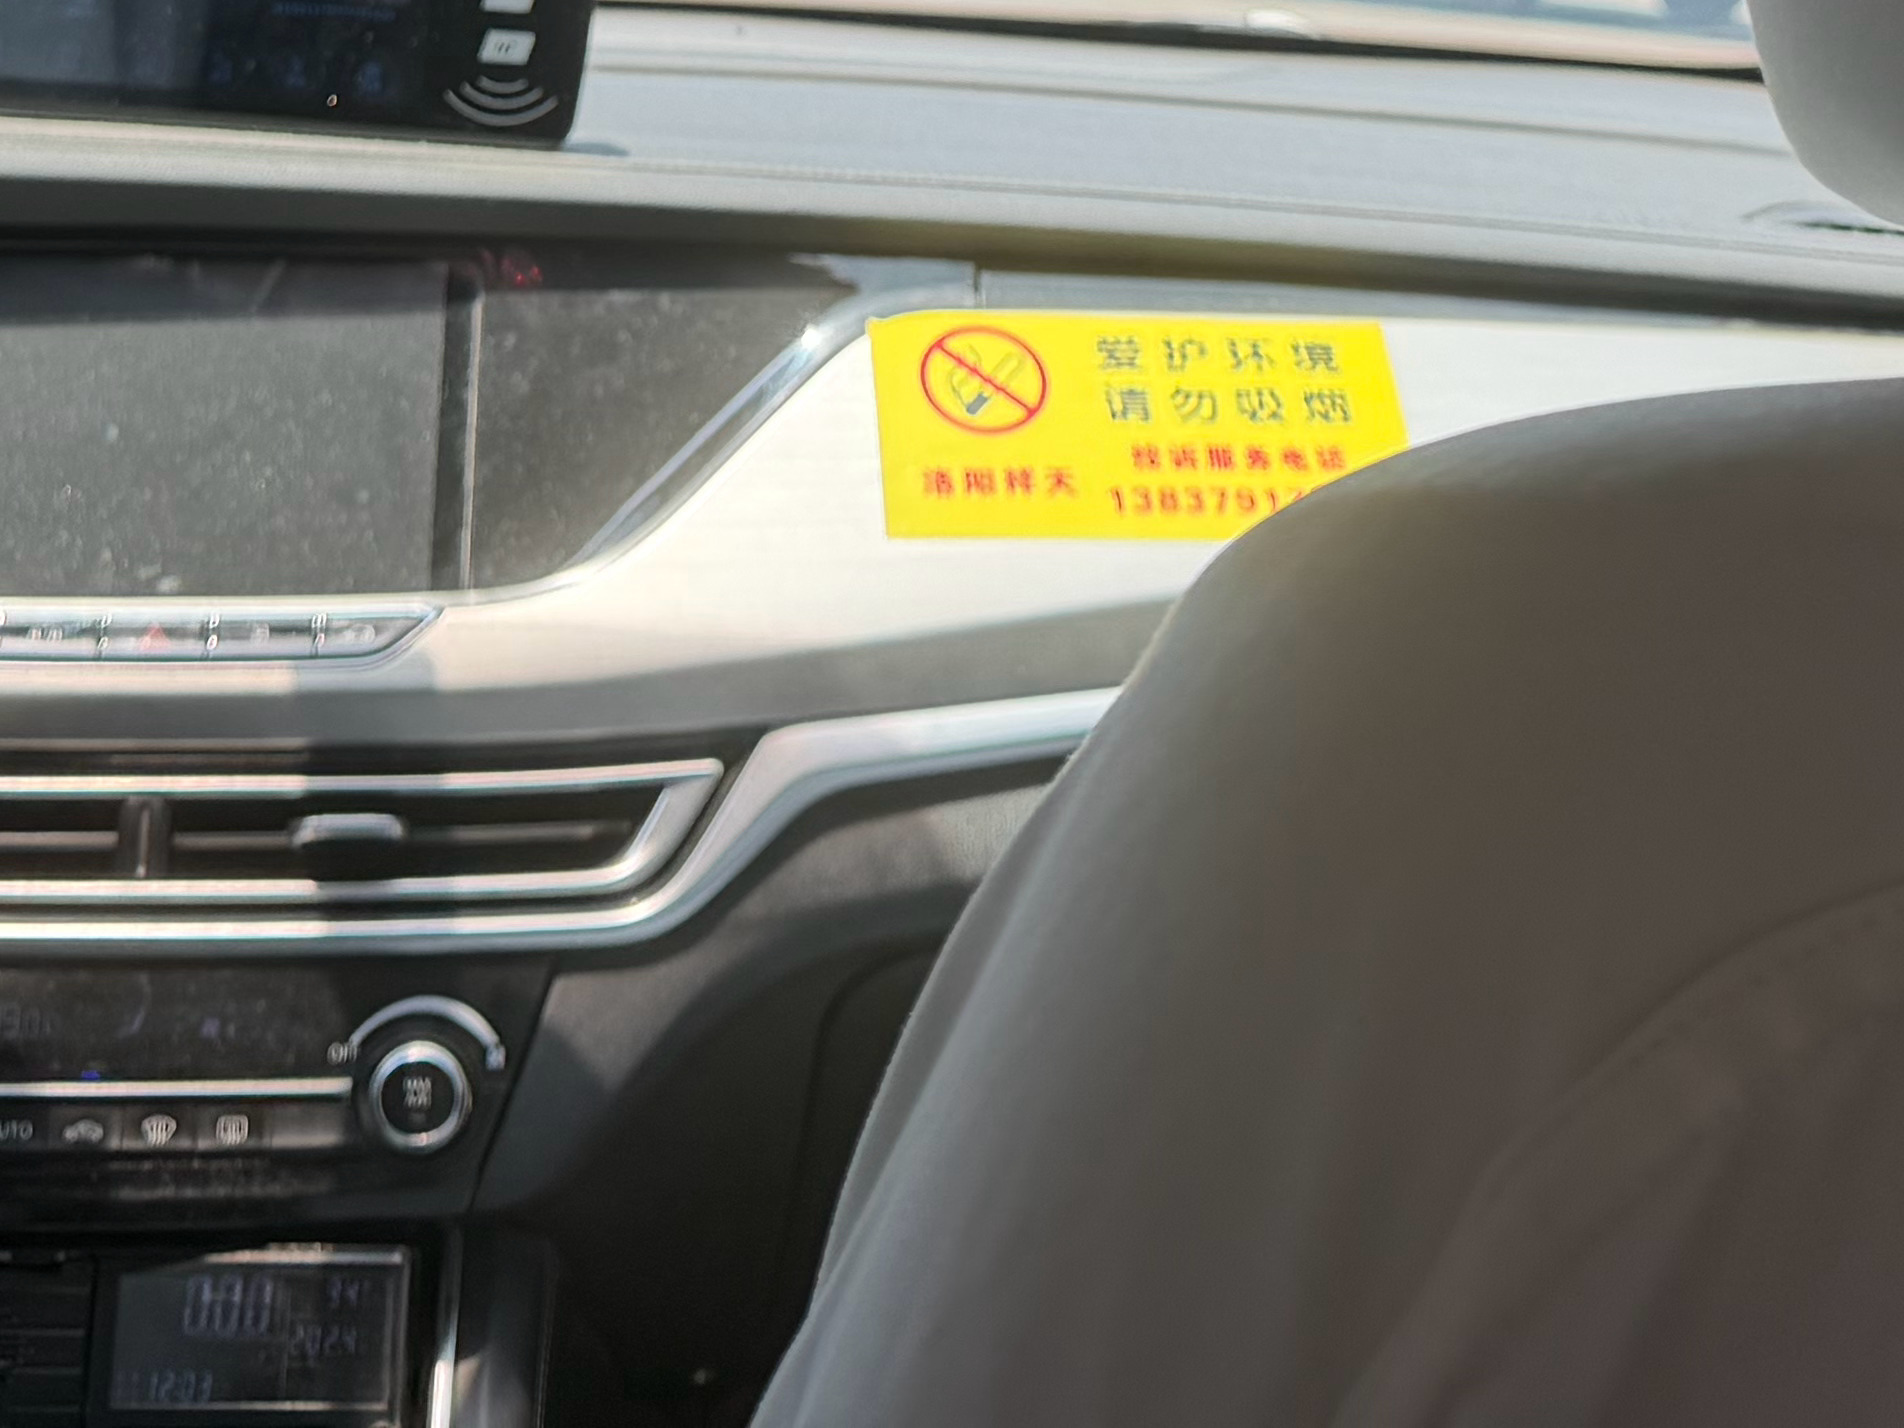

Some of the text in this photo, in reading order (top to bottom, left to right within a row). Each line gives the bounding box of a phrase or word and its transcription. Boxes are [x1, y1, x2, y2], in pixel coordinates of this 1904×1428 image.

[1096, 334, 1340, 374] 爱护环境
[1104, 385, 1353, 424] 请勿吸烟
